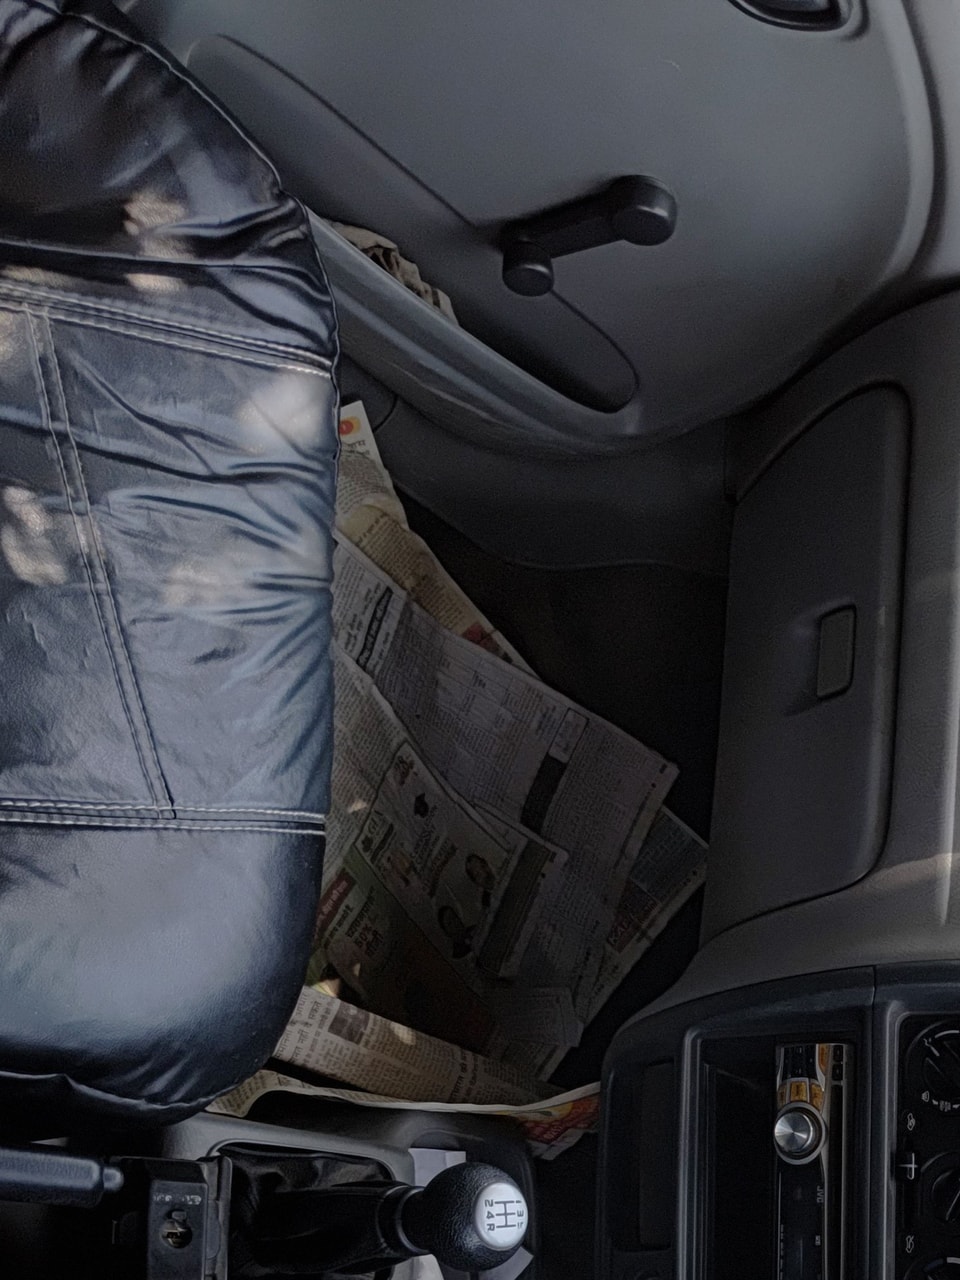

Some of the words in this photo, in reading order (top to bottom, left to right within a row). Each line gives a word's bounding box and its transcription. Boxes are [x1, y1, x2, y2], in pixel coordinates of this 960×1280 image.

[816, 1185, 824, 1203] JVC
[485, 1199, 493, 1207] 2
[486, 1211, 494, 1220] 4
[487, 1223, 495, 1232] R
